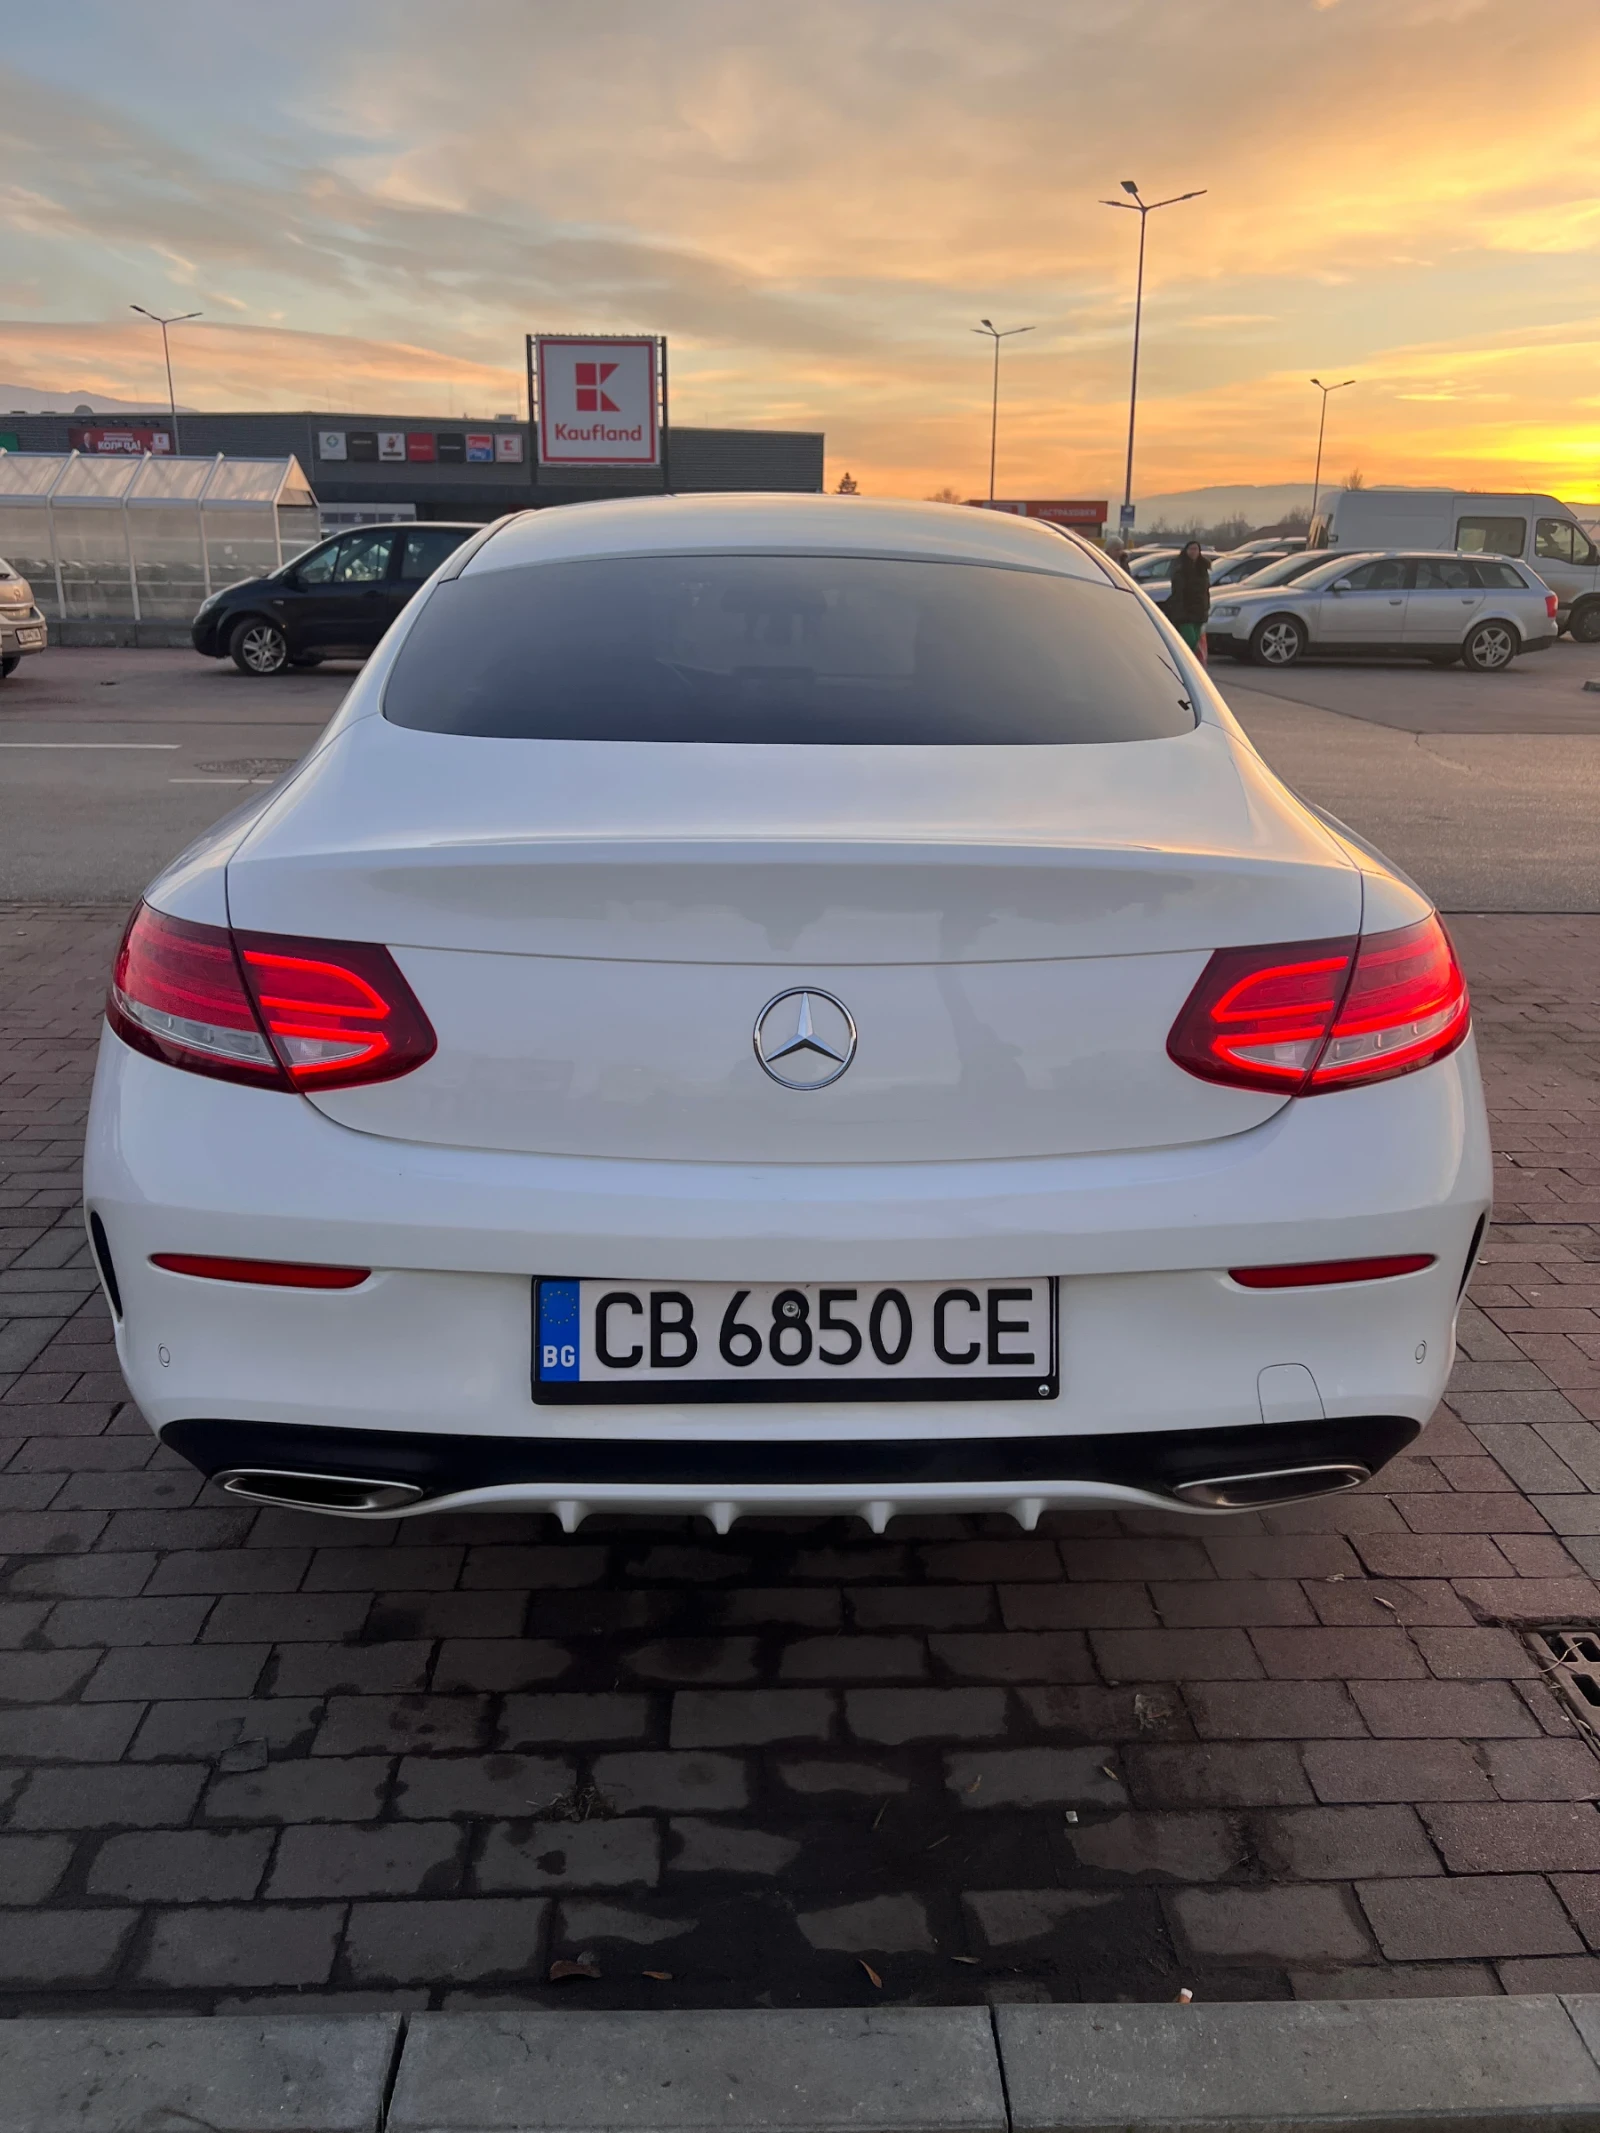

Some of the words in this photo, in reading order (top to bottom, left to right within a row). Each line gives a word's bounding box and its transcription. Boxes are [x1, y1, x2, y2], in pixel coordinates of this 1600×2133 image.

[555, 423, 642, 441] Kaufland
[595, 1291, 698, 1368] CB
[719, 1288, 912, 1367] 6850
[933, 1288, 1035, 1365] CE
[543, 1345, 575, 1368] BG
